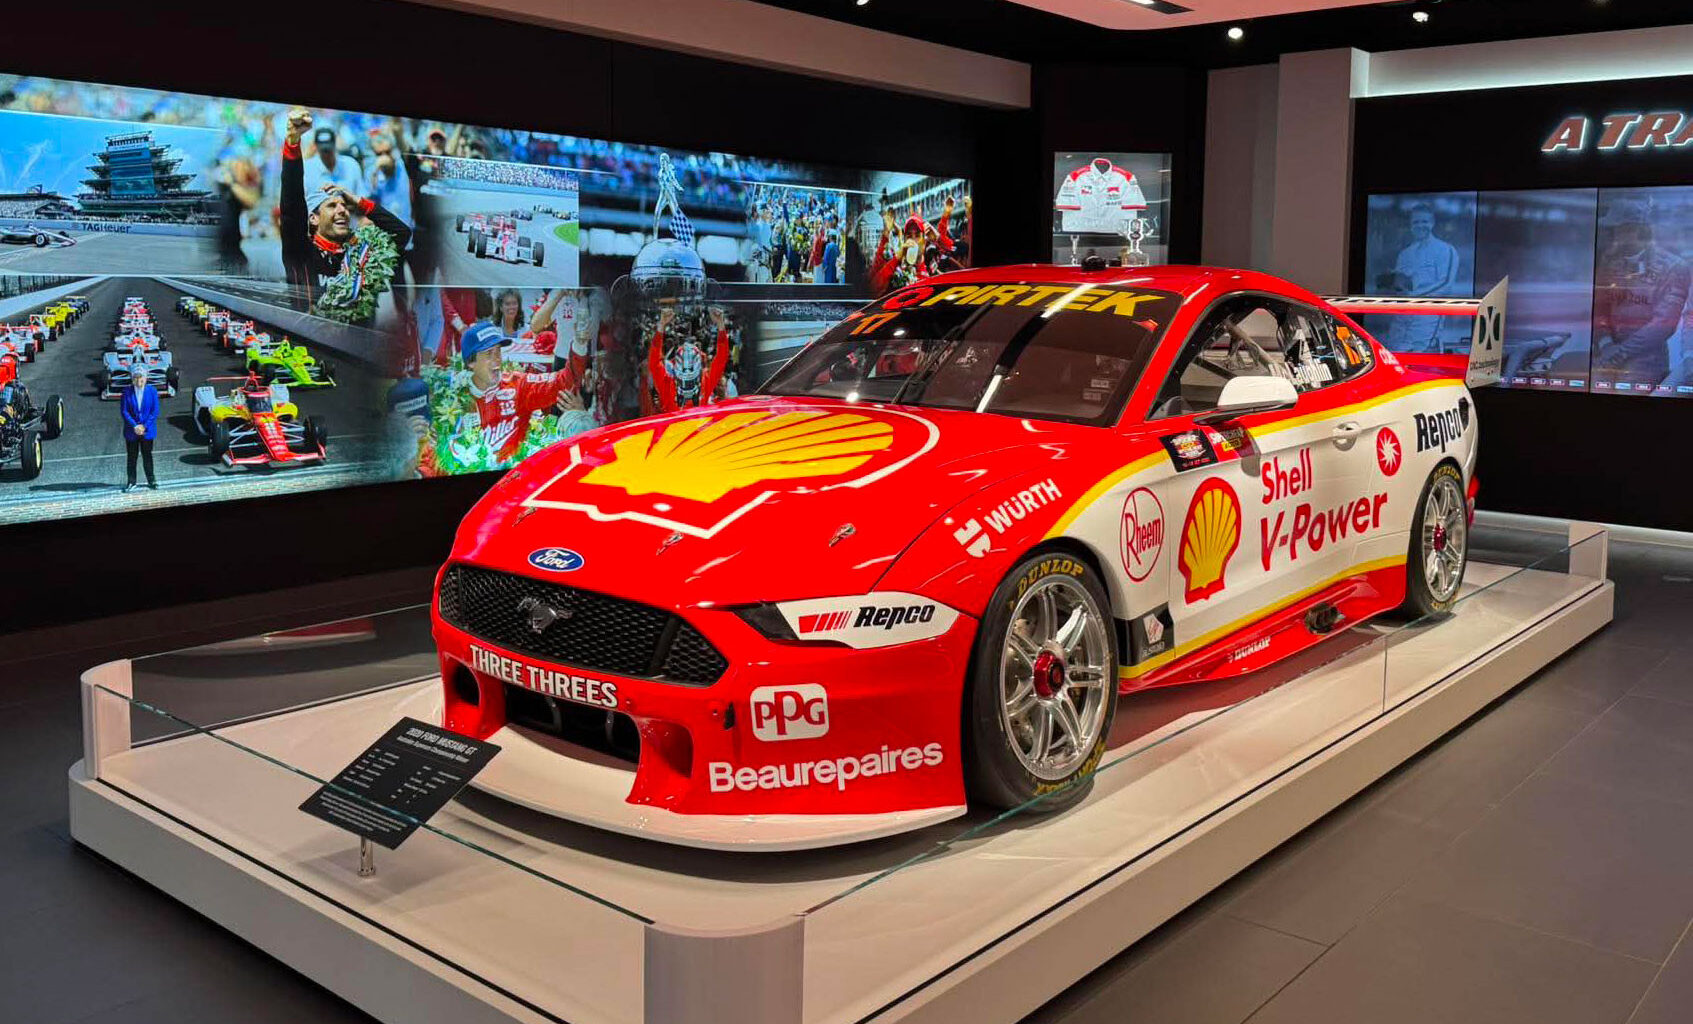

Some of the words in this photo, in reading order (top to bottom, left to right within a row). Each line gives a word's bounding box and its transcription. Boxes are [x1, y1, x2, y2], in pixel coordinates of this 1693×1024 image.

[1541, 116, 1588, 151] A
[850, 311, 901, 335] 17
[920, 285, 1165, 316] PIRTEK
[1414, 406, 1461, 453] Repco
[1261, 448, 1312, 505] Shell
[984, 478, 1062, 534] WÜRTH
[1124, 496, 1161, 568] Rheem
[1261, 492, 1388, 571] V-Power
[535, 549, 575, 568] Ford
[1017, 559, 1084, 598] DUNLOP
[853, 604, 936, 630] Repco
[470, 644, 525, 686] THREE
[526, 665, 619, 709] THREES
[754, 690, 826, 735] PPG
[708, 742, 944, 793] Beaurepaires
